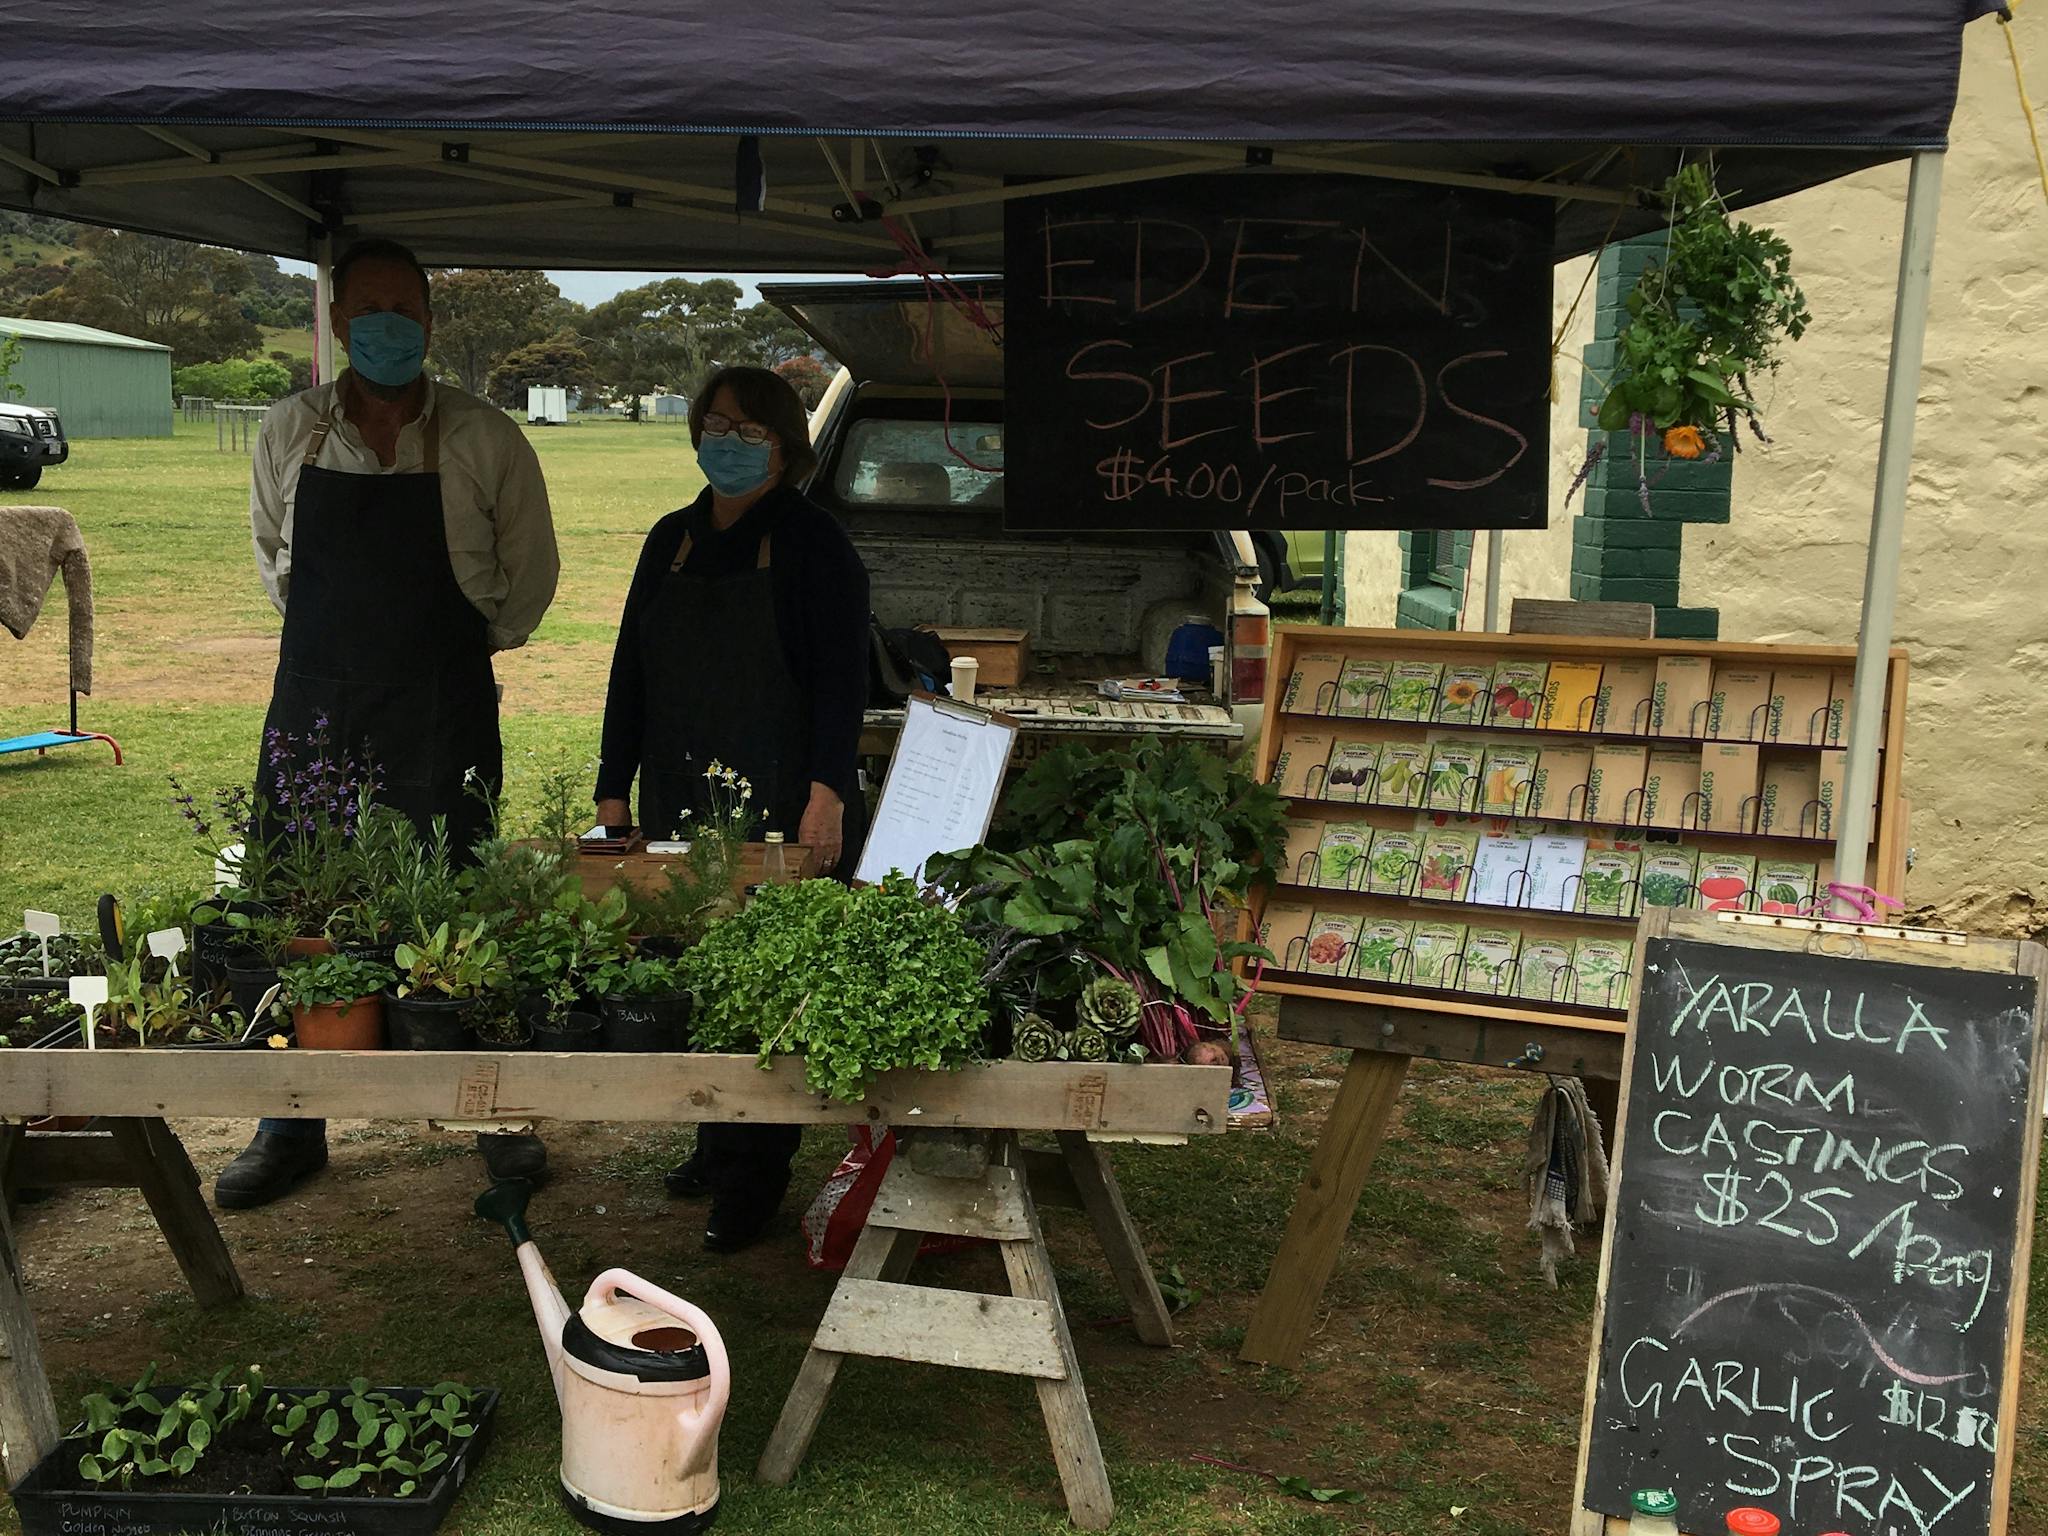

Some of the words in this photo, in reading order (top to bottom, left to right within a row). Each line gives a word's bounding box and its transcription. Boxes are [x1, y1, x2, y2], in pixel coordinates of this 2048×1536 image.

[1038, 208, 1452, 318] EDEN
[1066, 339, 1529, 490] SEEDS
[617, 1009, 656, 1023] BALM
[1670, 958, 1950, 1054] YARALLA
[1651, 1052, 1856, 1115] WORM
[1653, 1110, 1970, 1200] CASTINGS
[1621, 1336, 1855, 1442] GARLIC
[60, 1502, 132, 1520] PUMPKIN
[1723, 1433, 1976, 1535] SPRAY
